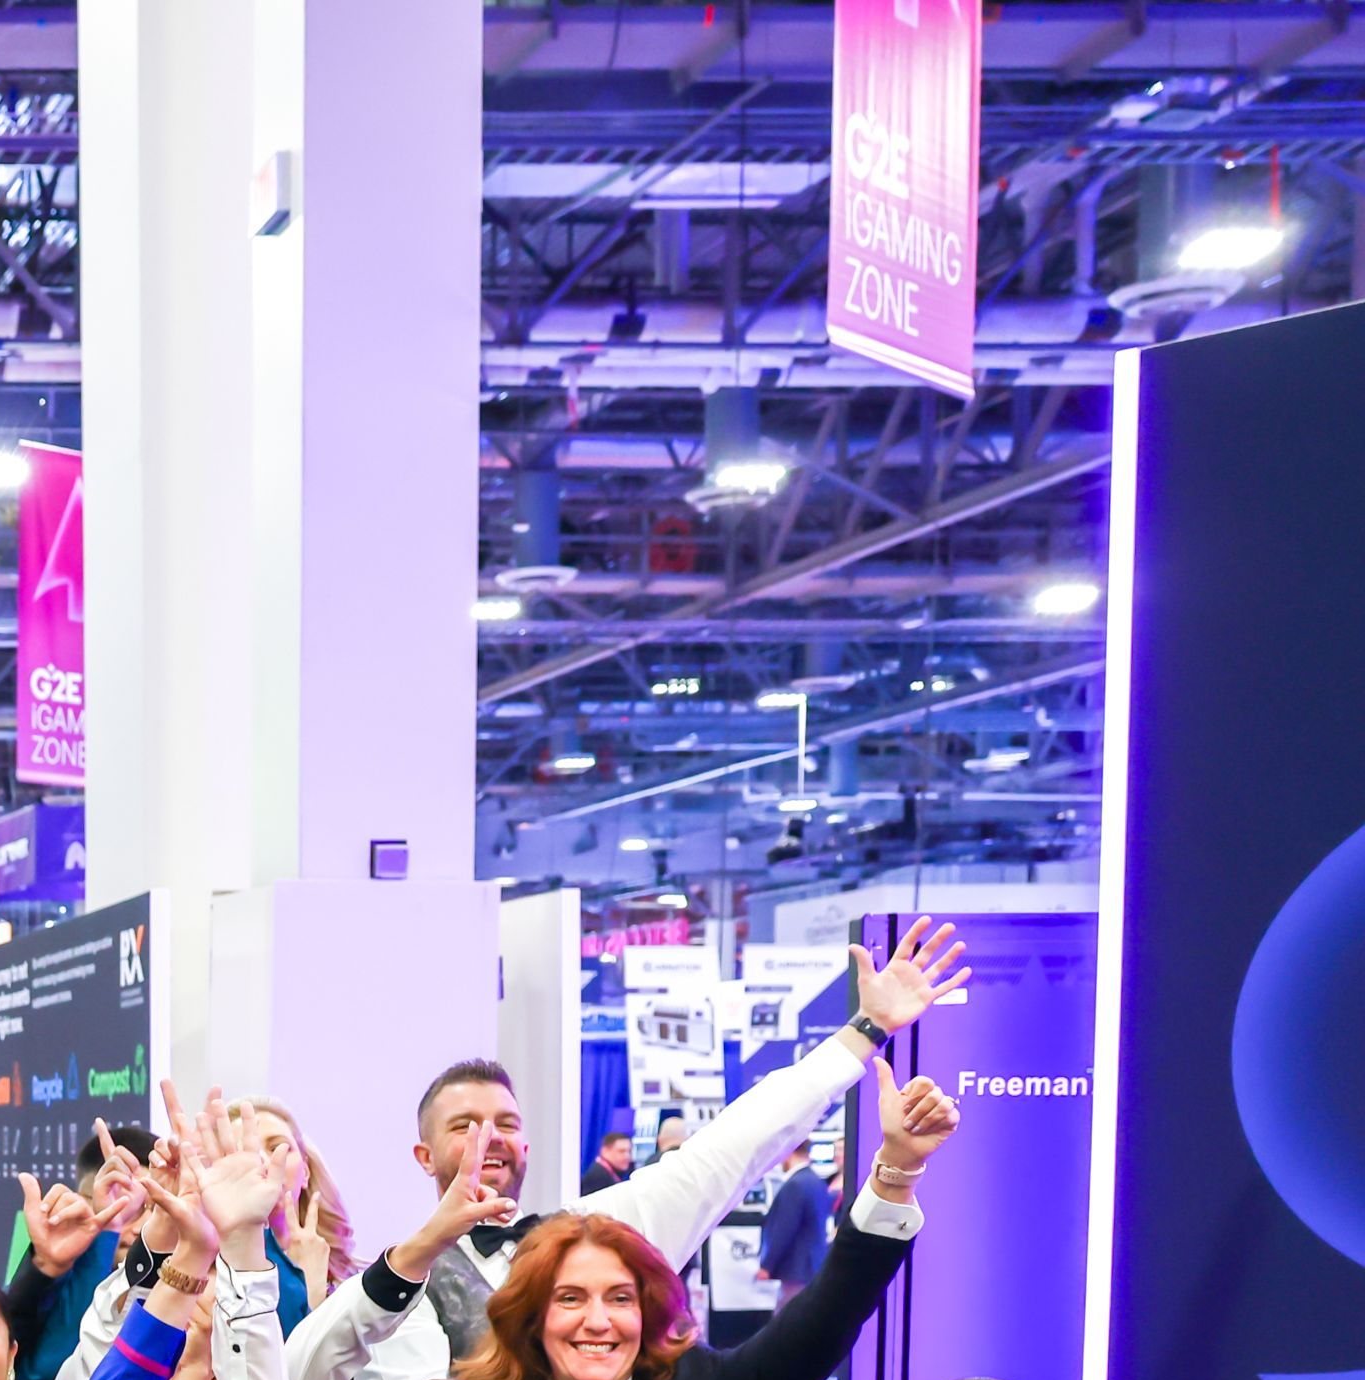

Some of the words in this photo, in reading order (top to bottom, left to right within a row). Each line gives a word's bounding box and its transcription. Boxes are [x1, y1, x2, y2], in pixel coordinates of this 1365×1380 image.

[844, 112, 910, 199] G2E
[844, 256, 919, 337] ZONE
[30, 665, 83, 704] G2E
[88, 1065, 130, 1102] Compost
